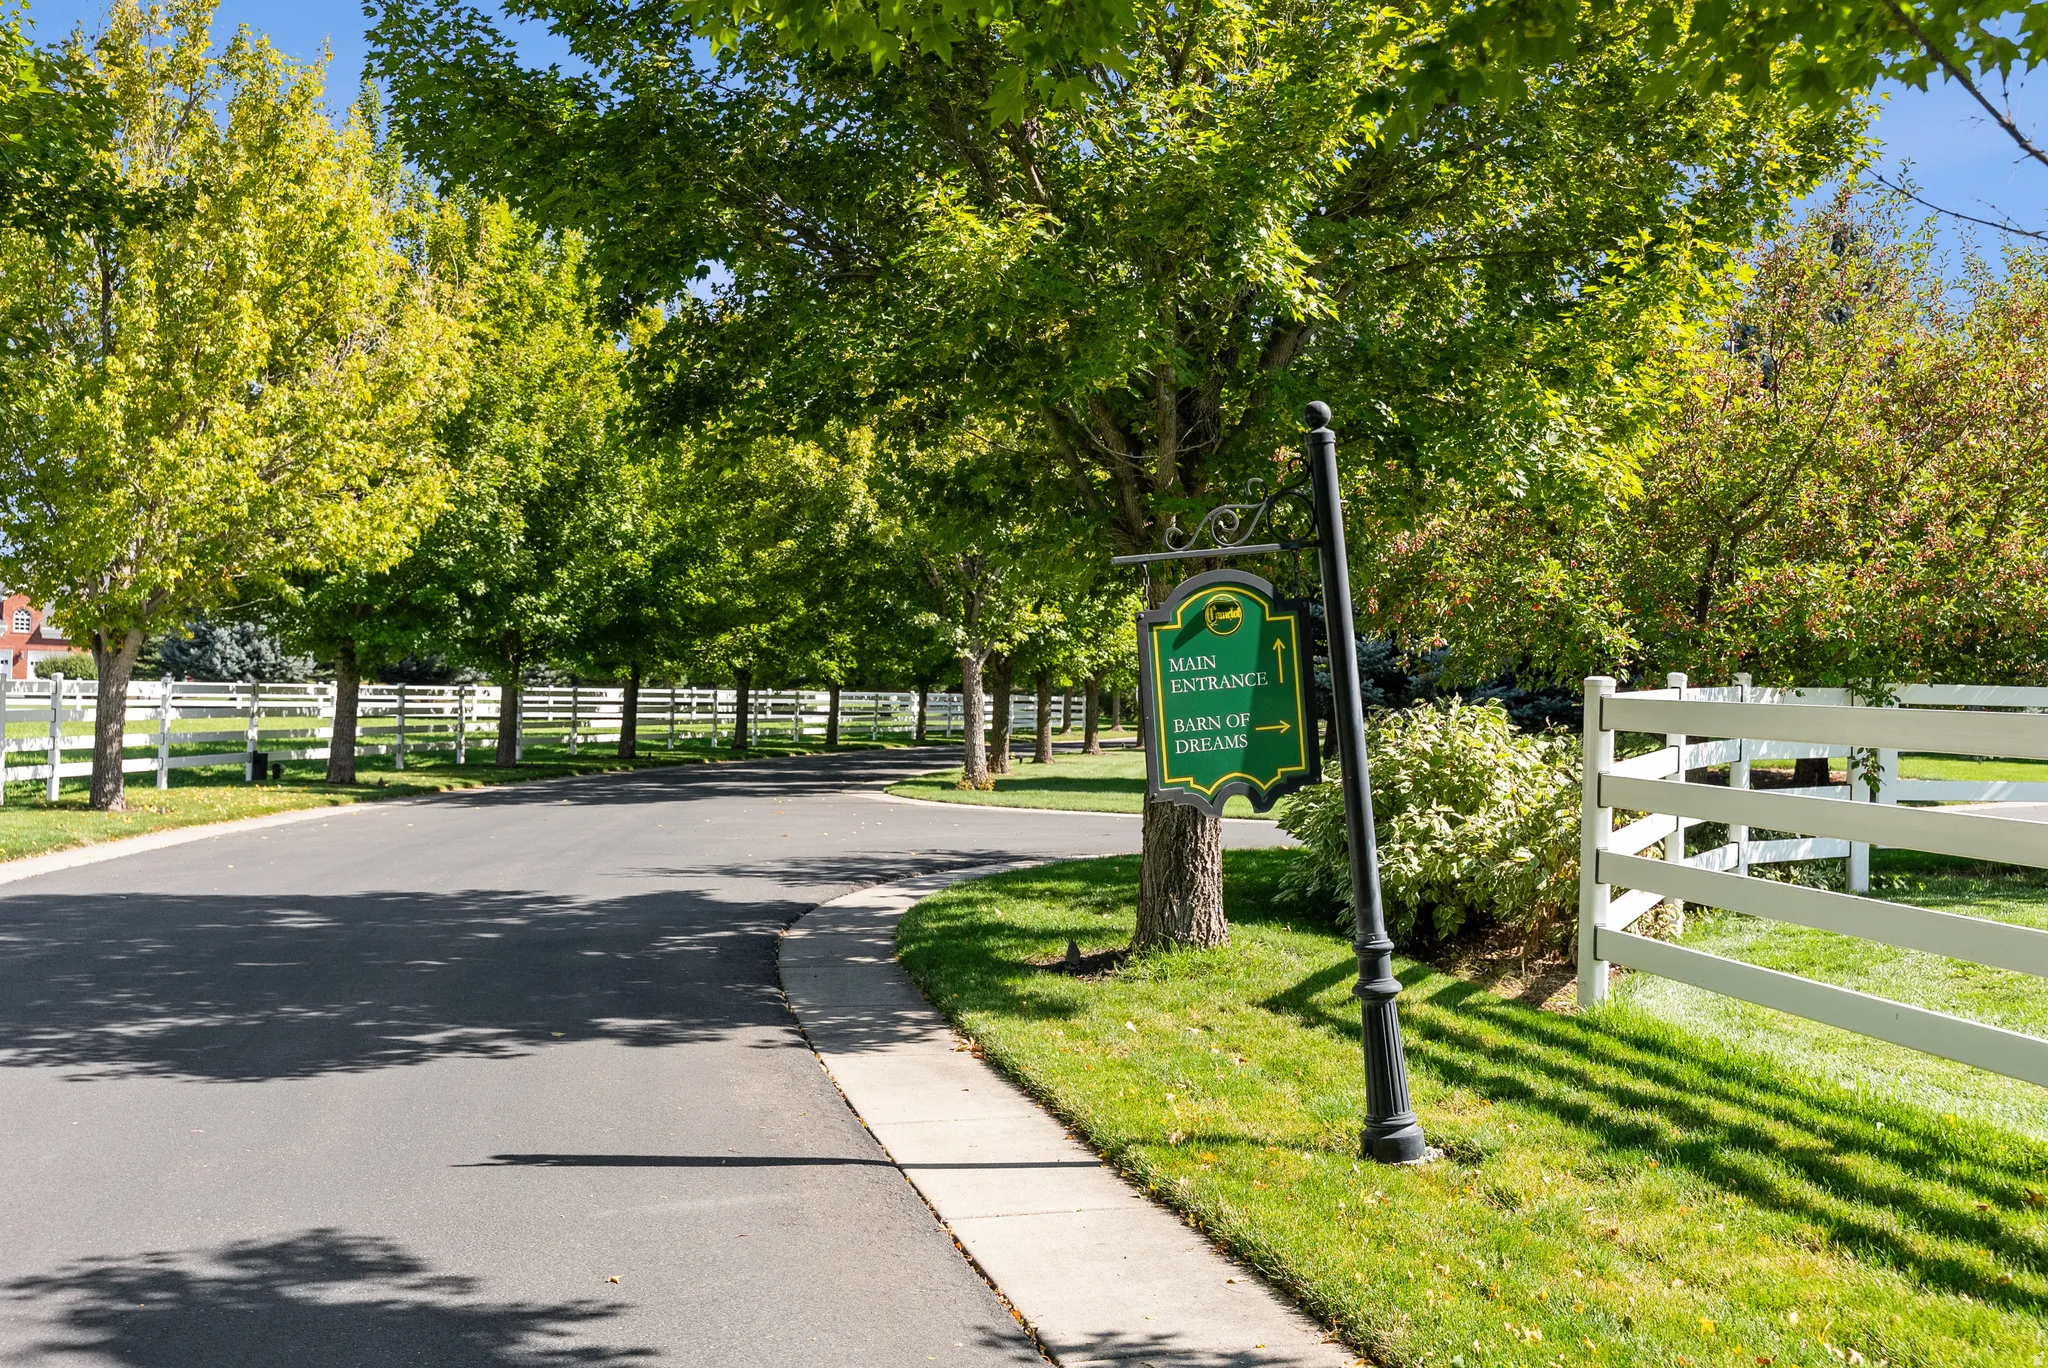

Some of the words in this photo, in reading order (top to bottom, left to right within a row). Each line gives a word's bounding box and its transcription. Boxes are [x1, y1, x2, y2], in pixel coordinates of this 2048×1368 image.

[1168, 655, 1217, 673] MAIN
[1170, 672, 1269, 694] ENTRANCE
[1173, 715, 1222, 733] BARN
[1226, 712, 1251, 728] OF
[1175, 734, 1249, 754] DREAMS
